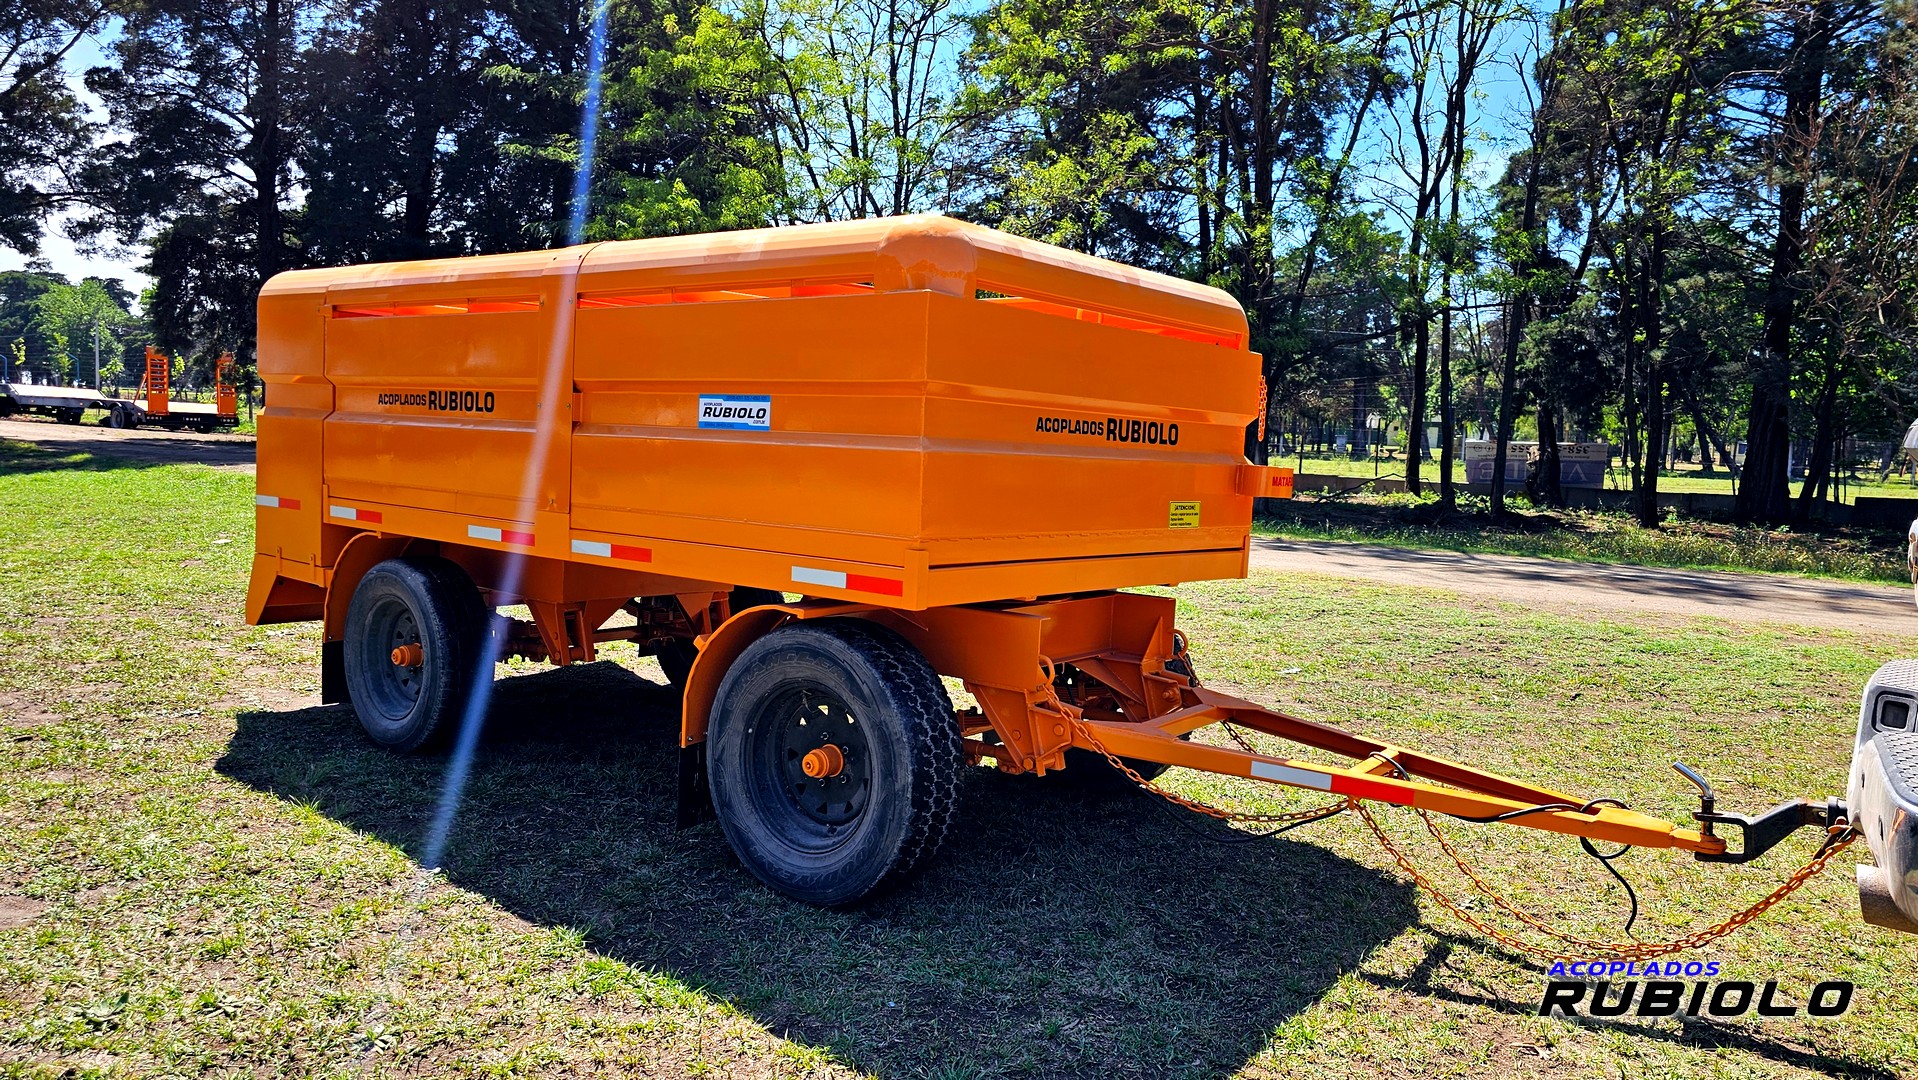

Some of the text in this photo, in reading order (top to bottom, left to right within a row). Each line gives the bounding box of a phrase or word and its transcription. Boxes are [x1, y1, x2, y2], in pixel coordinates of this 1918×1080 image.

[378, 391, 495, 413] ACOPLADOS RUBIOLO
[703, 407, 767, 419] RUBIOLO
[1036, 417, 1179, 446] ACOPLADOS RUBIOLO
